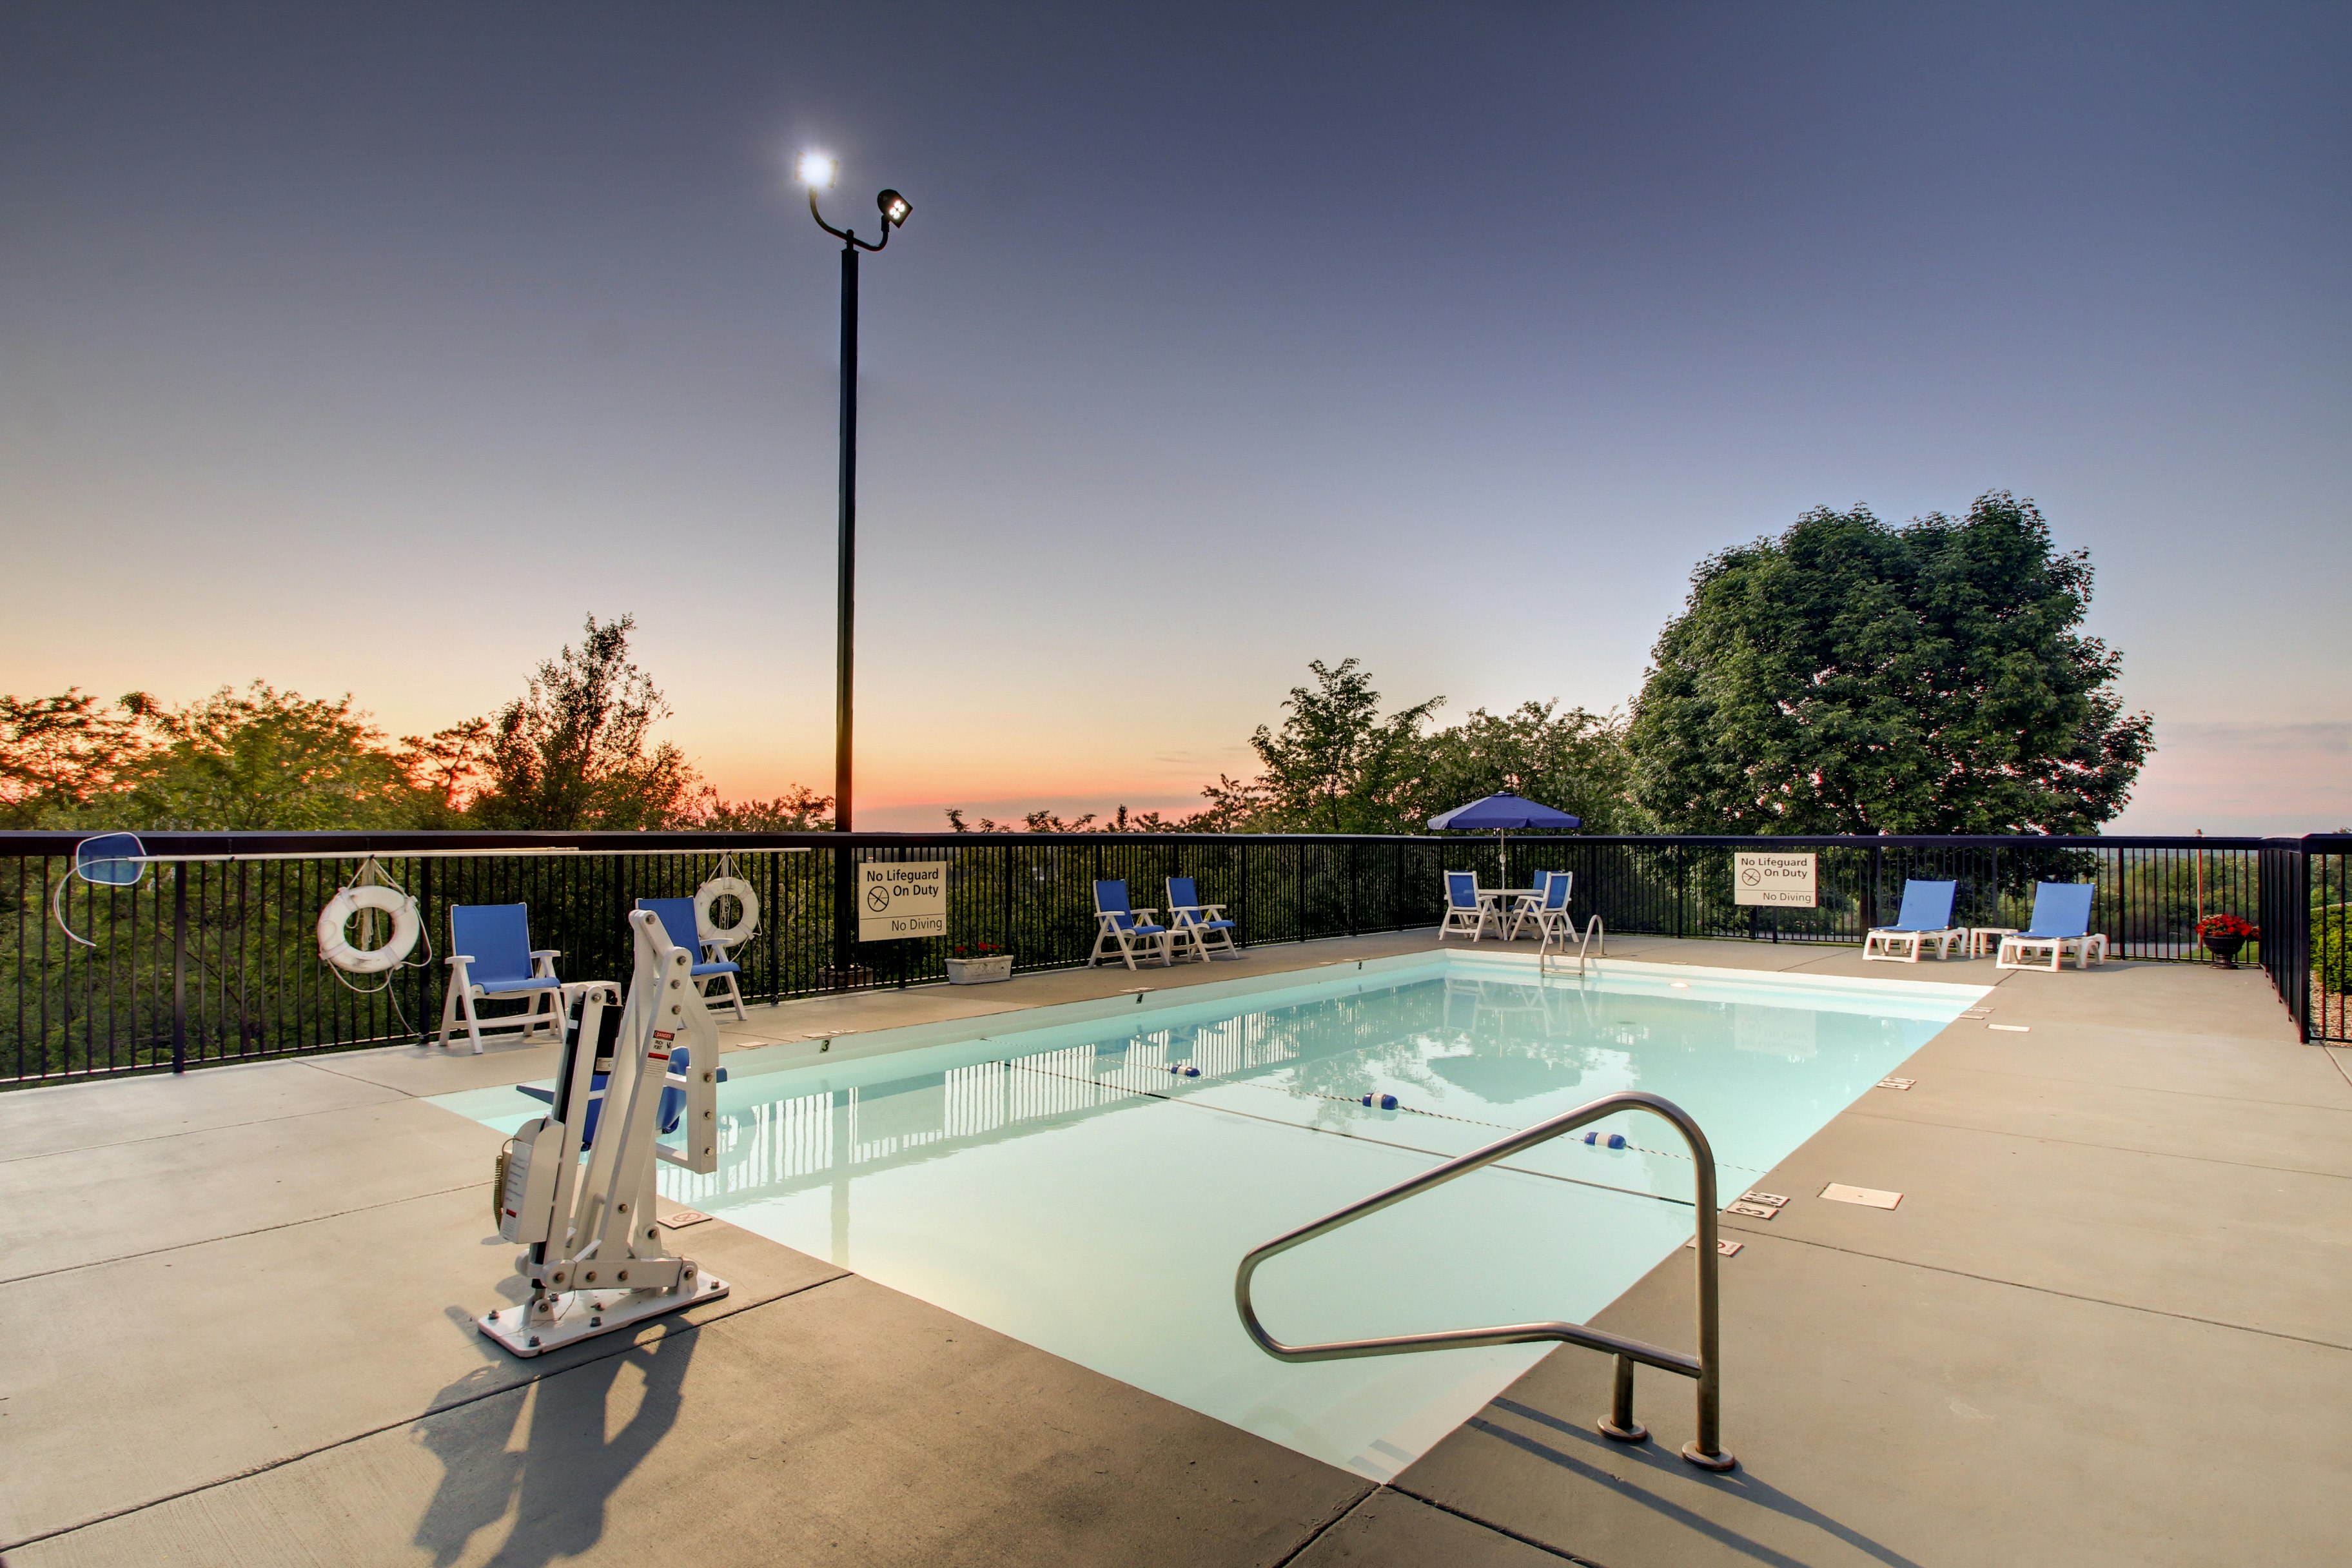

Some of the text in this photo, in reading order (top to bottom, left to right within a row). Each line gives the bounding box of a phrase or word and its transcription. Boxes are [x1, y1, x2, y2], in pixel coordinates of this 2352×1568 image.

[1758, 858, 1807, 868] Lifeguard
[867, 868, 939, 883] No Lifeguard
[1783, 869, 1807, 879] Duty
[893, 885, 939, 897] On Duty
[1779, 893, 1811, 904] Diving
[892, 917, 942, 931] No Diving
[1137, 994, 1144, 1004] 4
[821, 1040, 829, 1052] 3
